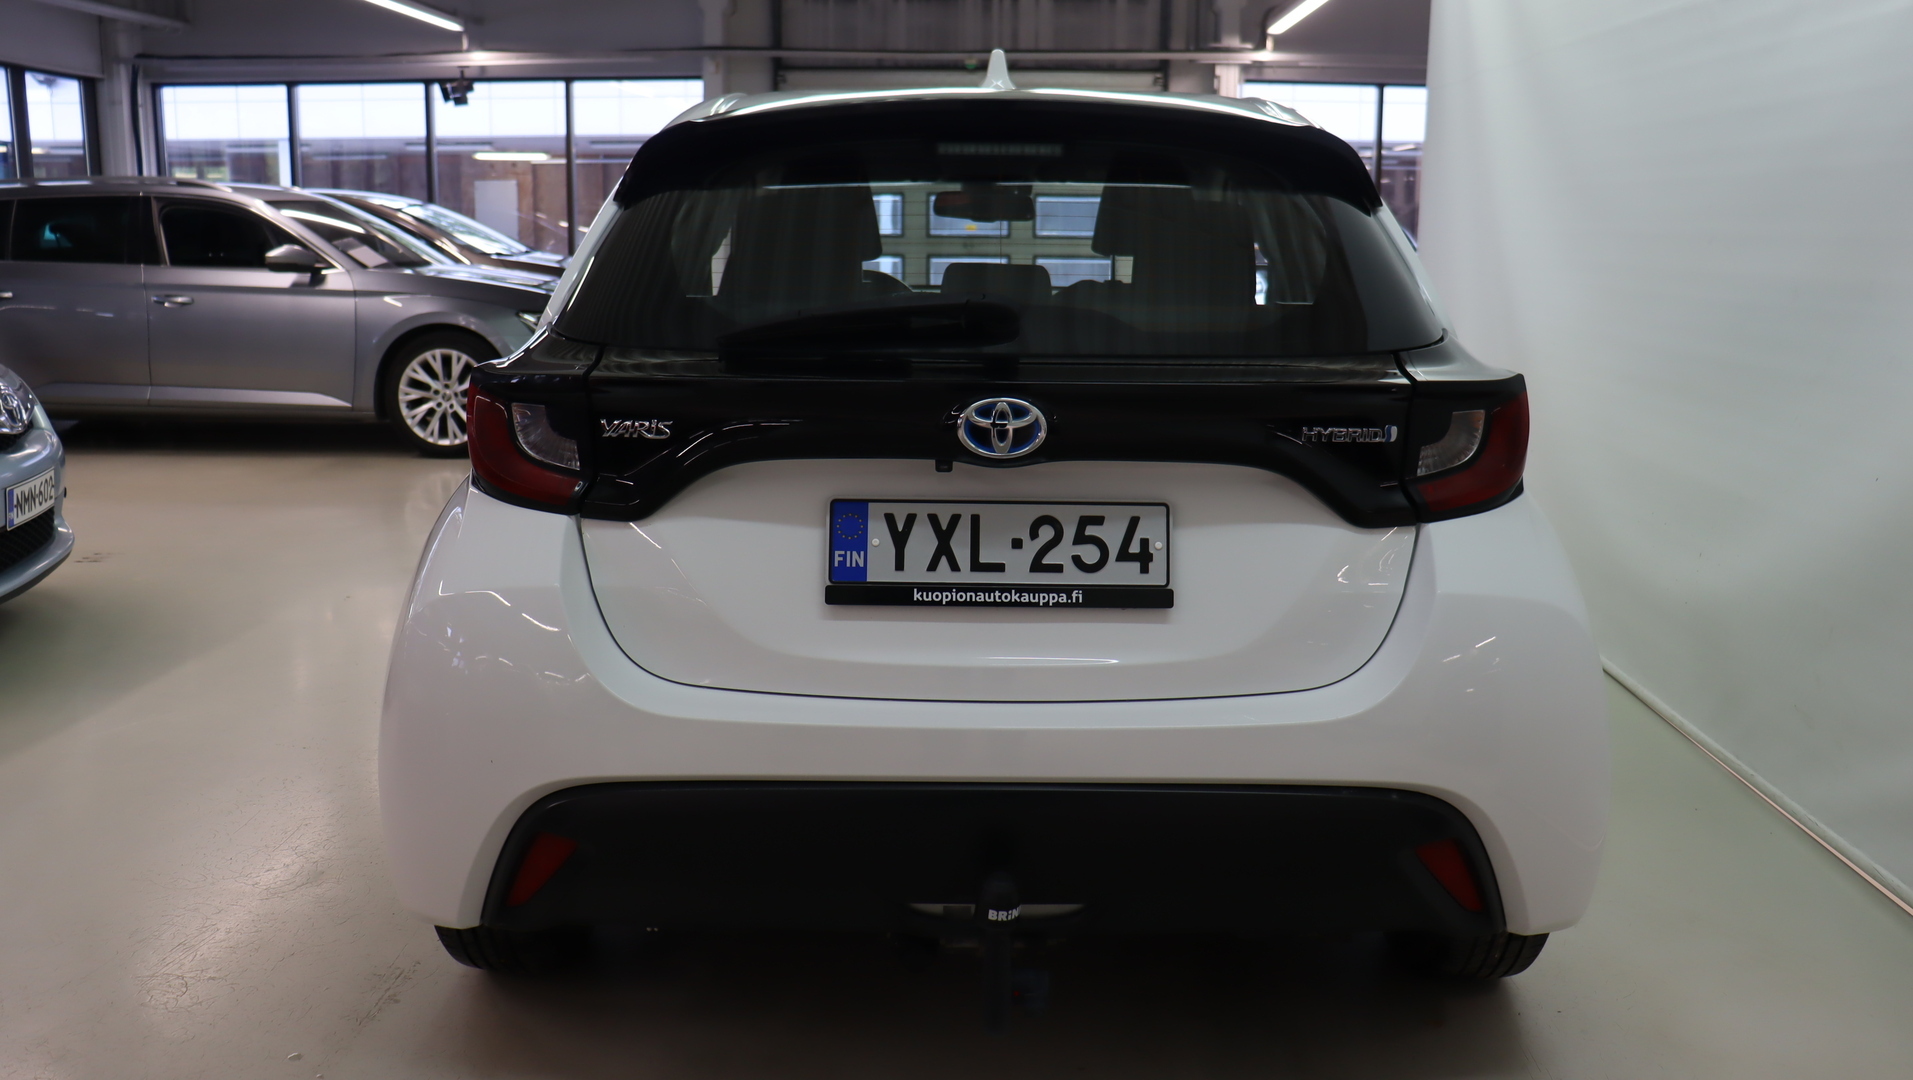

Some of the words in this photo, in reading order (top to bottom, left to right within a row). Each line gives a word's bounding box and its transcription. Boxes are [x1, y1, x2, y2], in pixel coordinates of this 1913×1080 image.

[1302, 426, 1385, 443] HYBRID
[15, 475, 54, 519] NMN-602
[883, 512, 1154, 574] YXL-254
[834, 550, 865, 568] FIN
[913, 588, 1083, 606] kuopionautokauppa.fi
